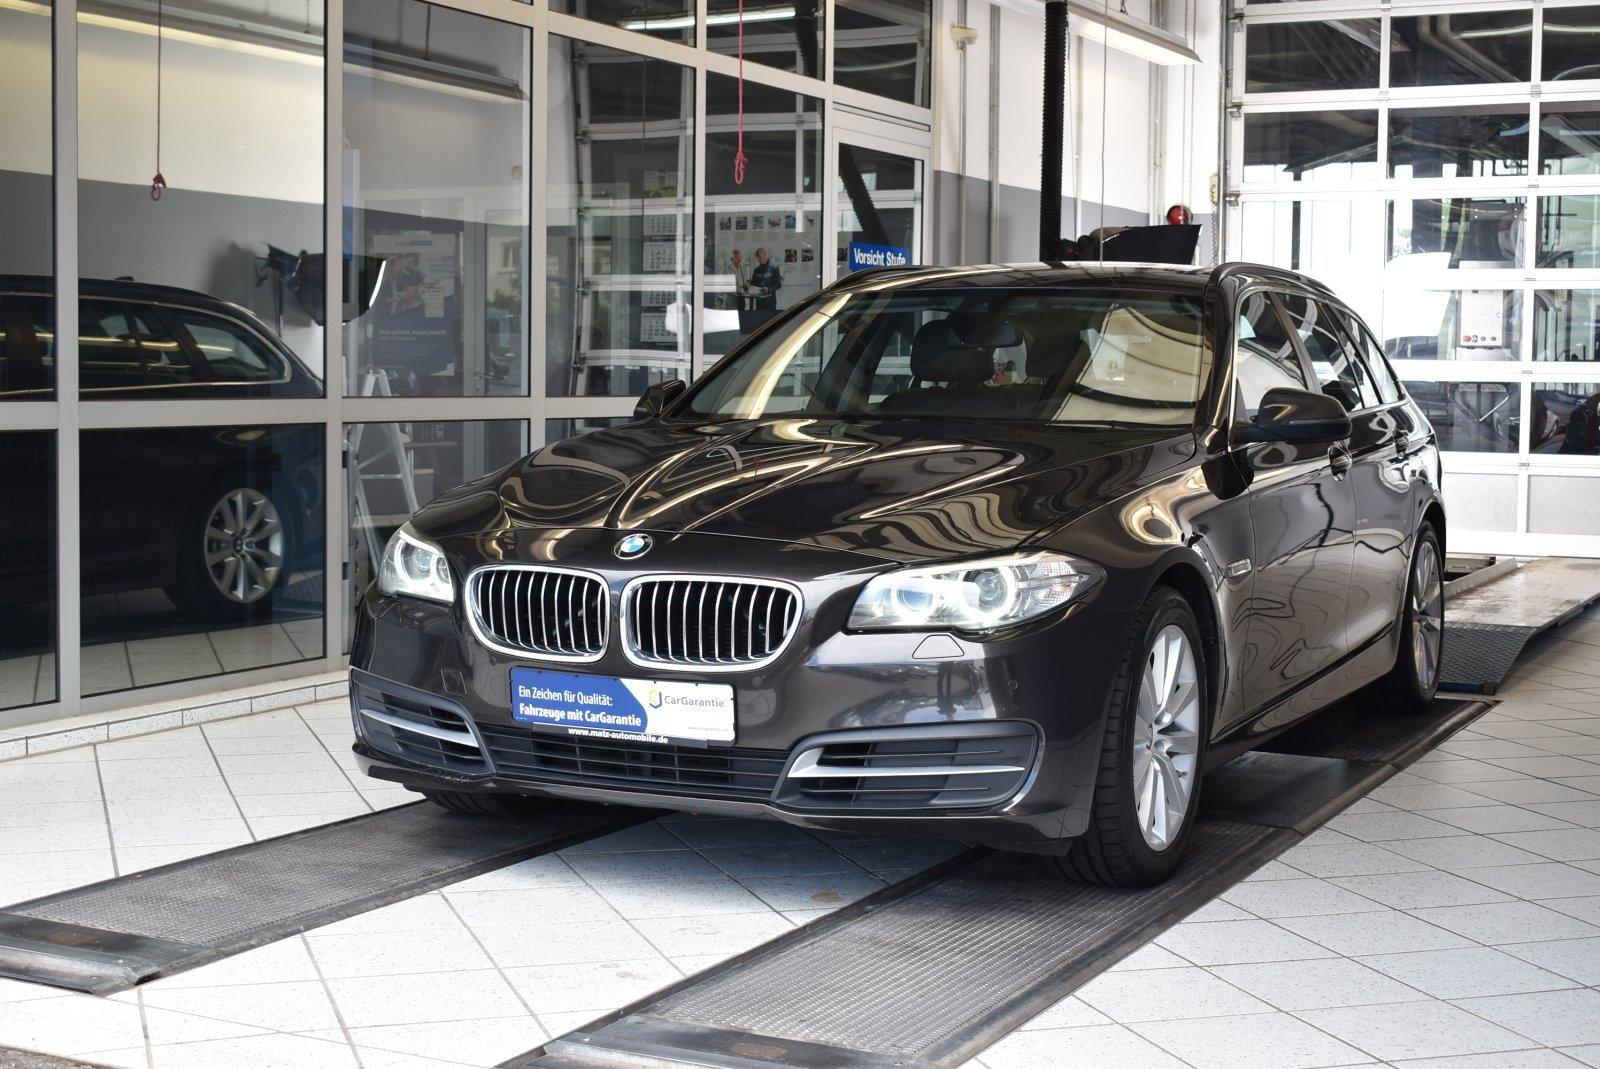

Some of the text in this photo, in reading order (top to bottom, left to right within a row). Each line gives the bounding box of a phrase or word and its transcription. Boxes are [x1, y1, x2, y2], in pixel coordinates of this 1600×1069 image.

[853, 247, 906, 266] Vorsicht Stufe
[518, 685, 613, 706] Ein Zeichen für Qualität:
[664, 695, 726, 708] CarGarantie
[519, 703, 642, 727] Fahrzeuge mit CarGarantie
[567, 728, 669, 744] www.matz-automobile.de
